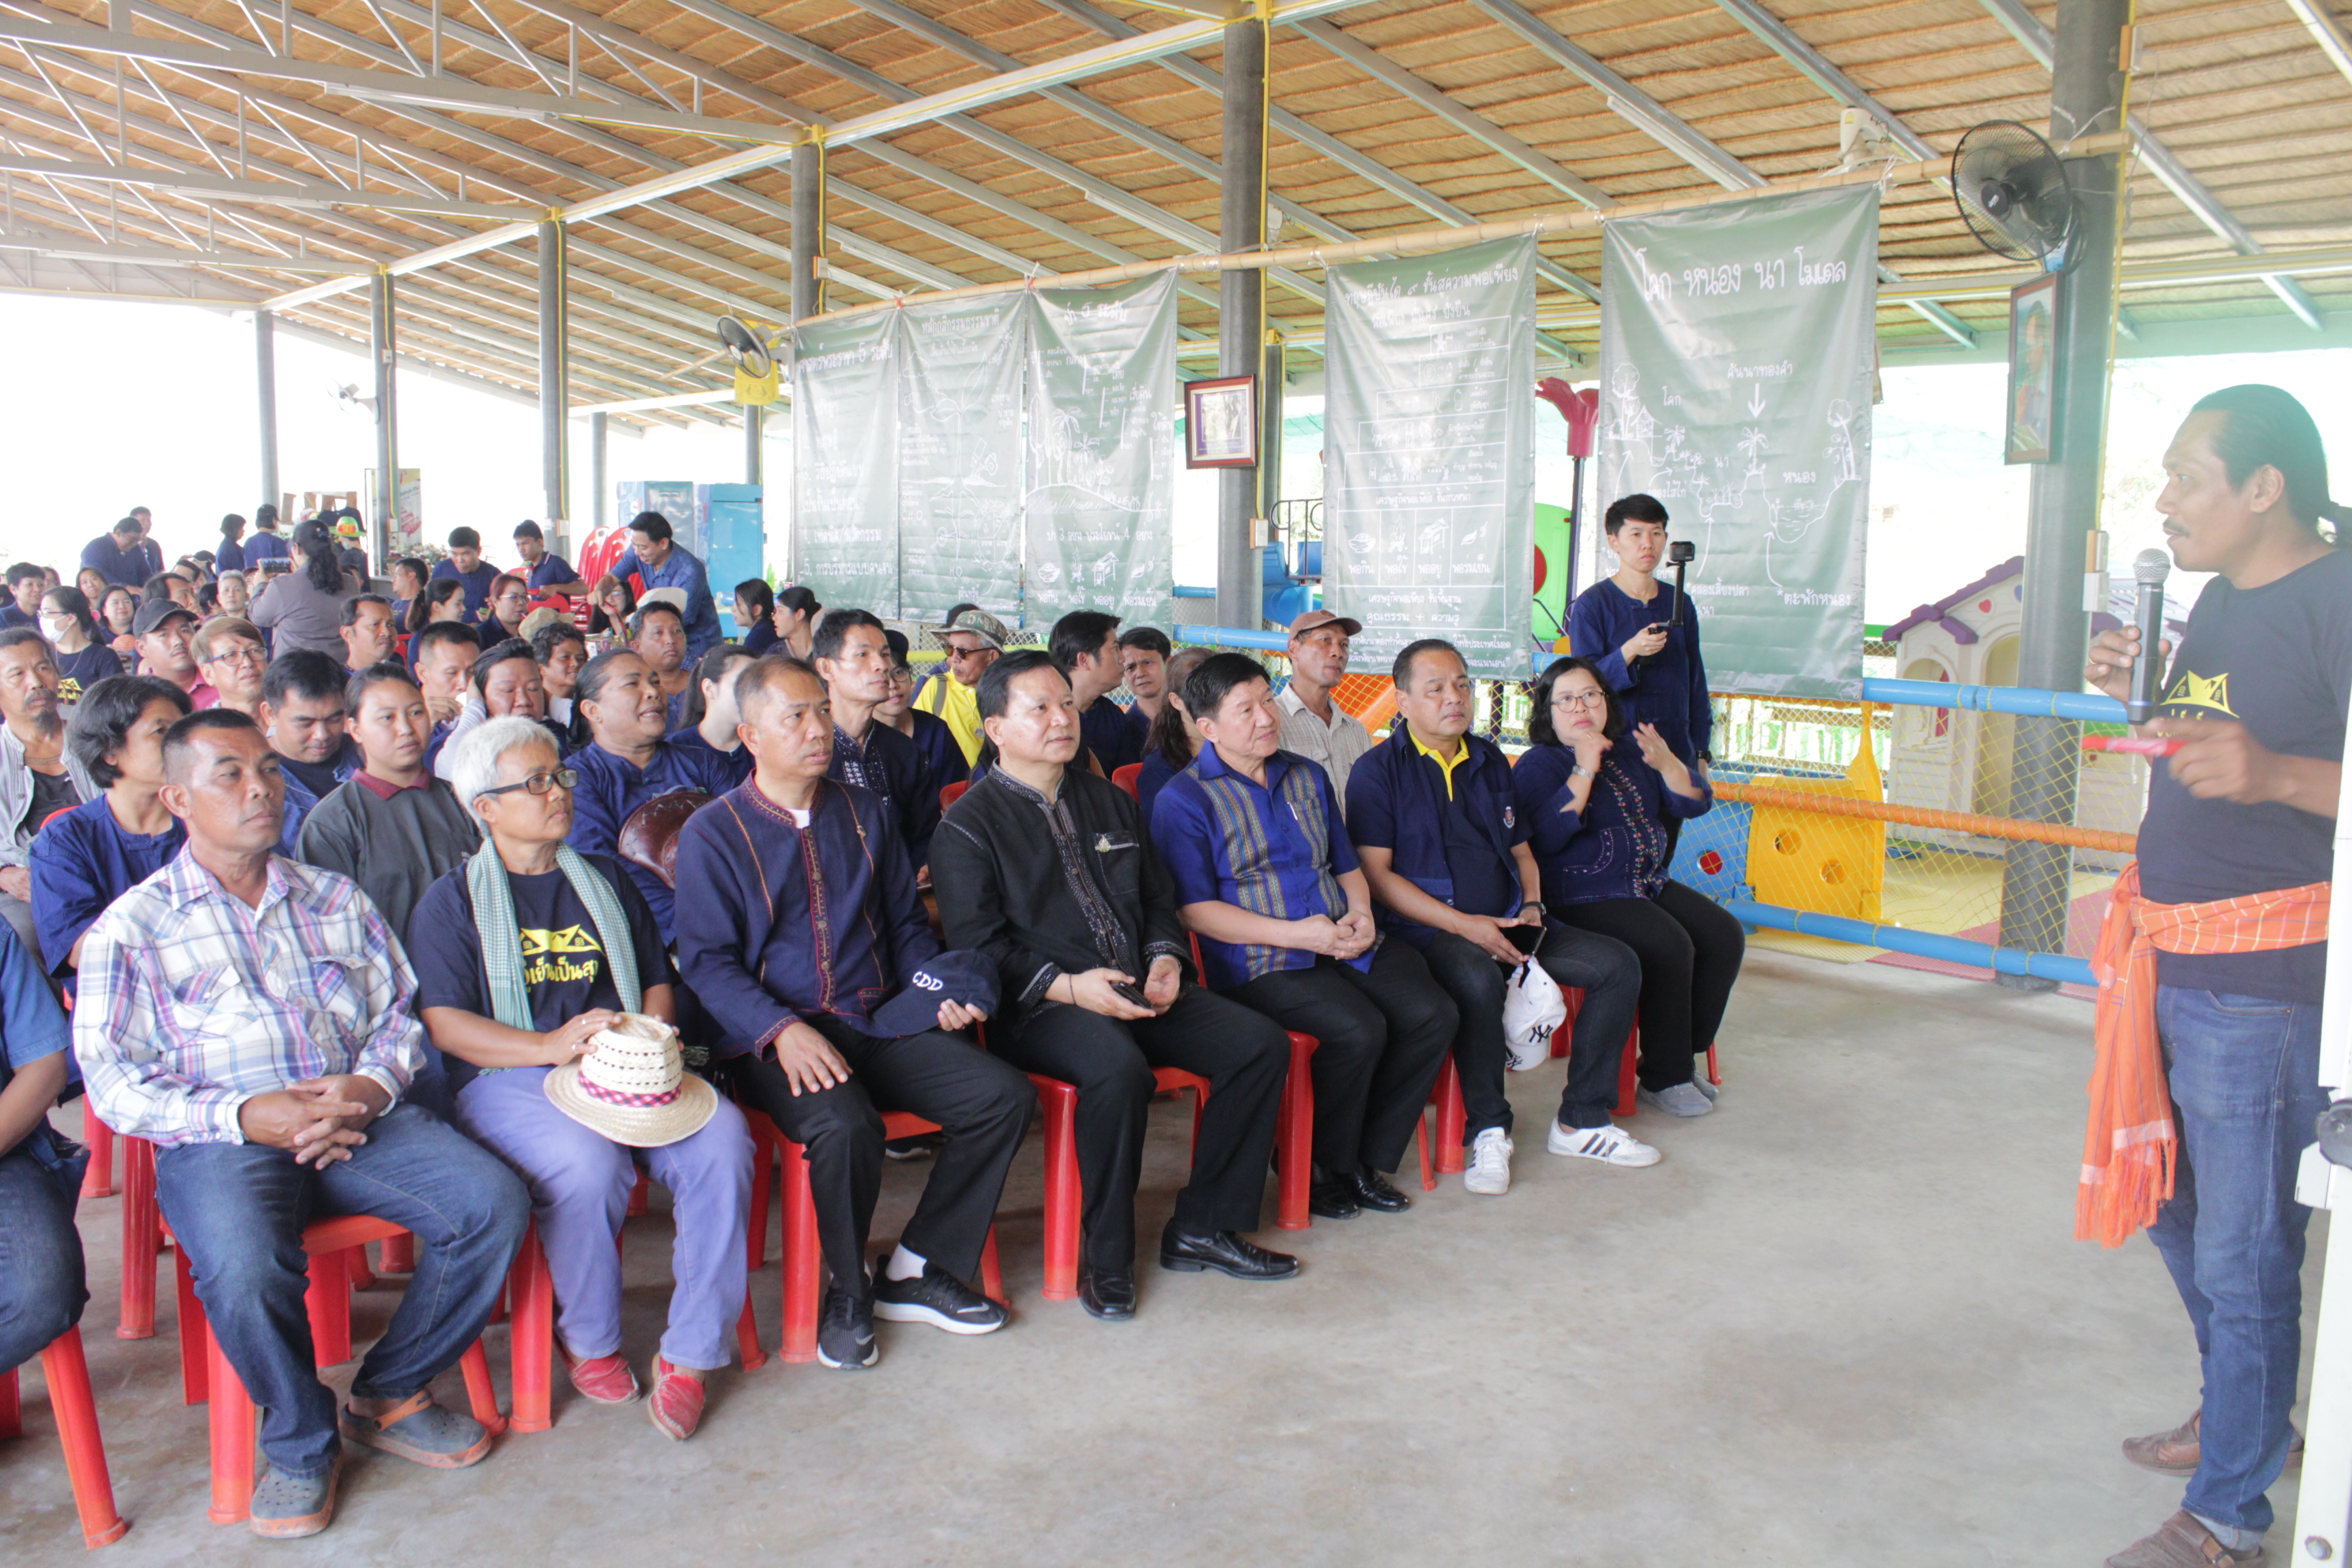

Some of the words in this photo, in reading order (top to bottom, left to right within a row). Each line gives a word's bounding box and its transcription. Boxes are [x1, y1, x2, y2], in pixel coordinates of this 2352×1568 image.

[1636, 248, 1671, 301] โคก
[1684, 263, 1741, 296] หนอง
[1754, 259, 1784, 290] นา
[1794, 246, 1846, 286] โมเดล
[921, 308, 1000, 334] หลักกสิกรรมธรรมชาติ
[859, 342, 866, 363] 5
[1728, 360, 1793, 378] คันนาทองคำ
[1662, 386, 1681, 407] โคก
[1714, 456, 1729, 468] นา
[1782, 470, 1816, 484] หนอง
[1060, 529, 1065, 540] 3
[1124, 527, 1130, 539] 4
[1348, 560, 1375, 574] พอกิน
[1367, 612, 1409, 625] คุณธรรม
[912, 970, 944, 991] CDD
